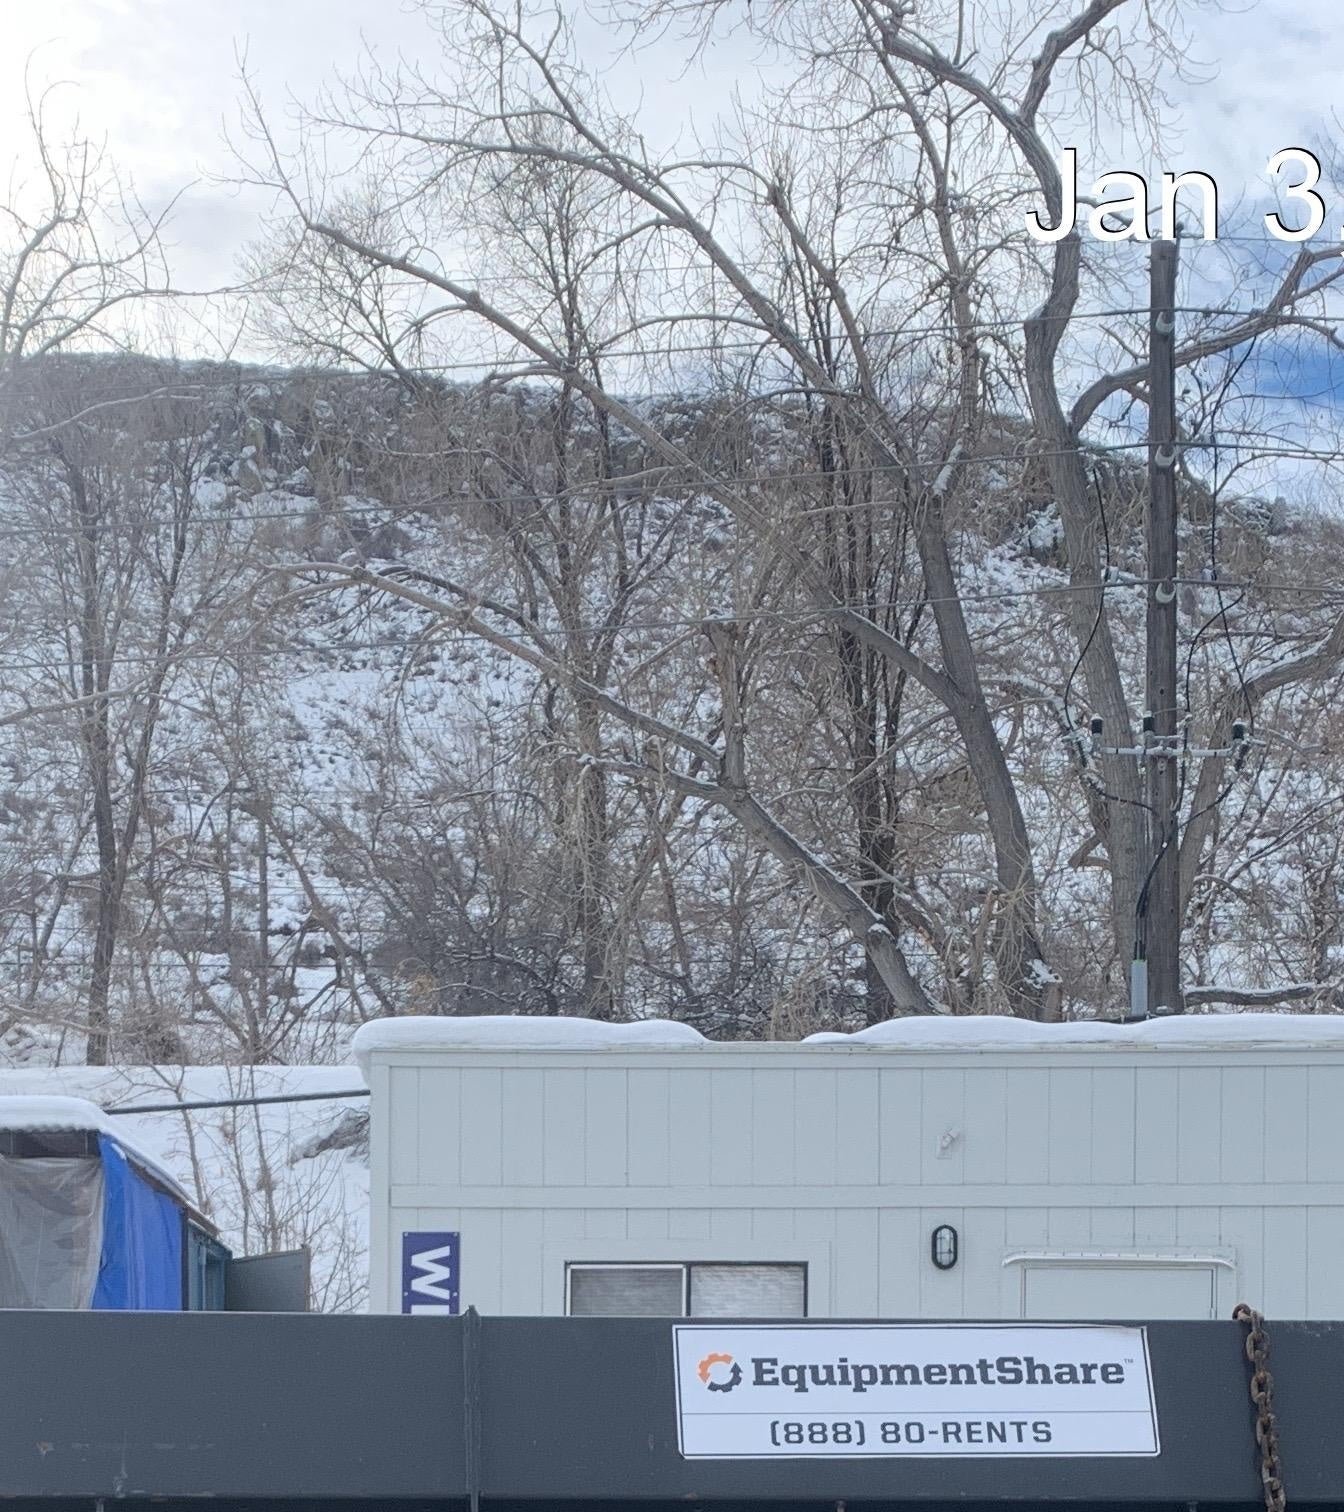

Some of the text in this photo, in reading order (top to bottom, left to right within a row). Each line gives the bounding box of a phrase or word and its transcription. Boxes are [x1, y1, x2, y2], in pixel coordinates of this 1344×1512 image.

[751, 1356, 1125, 1393] EquipmentShare
[770, 1420, 1053, 1446] (888) 80-RENTS
